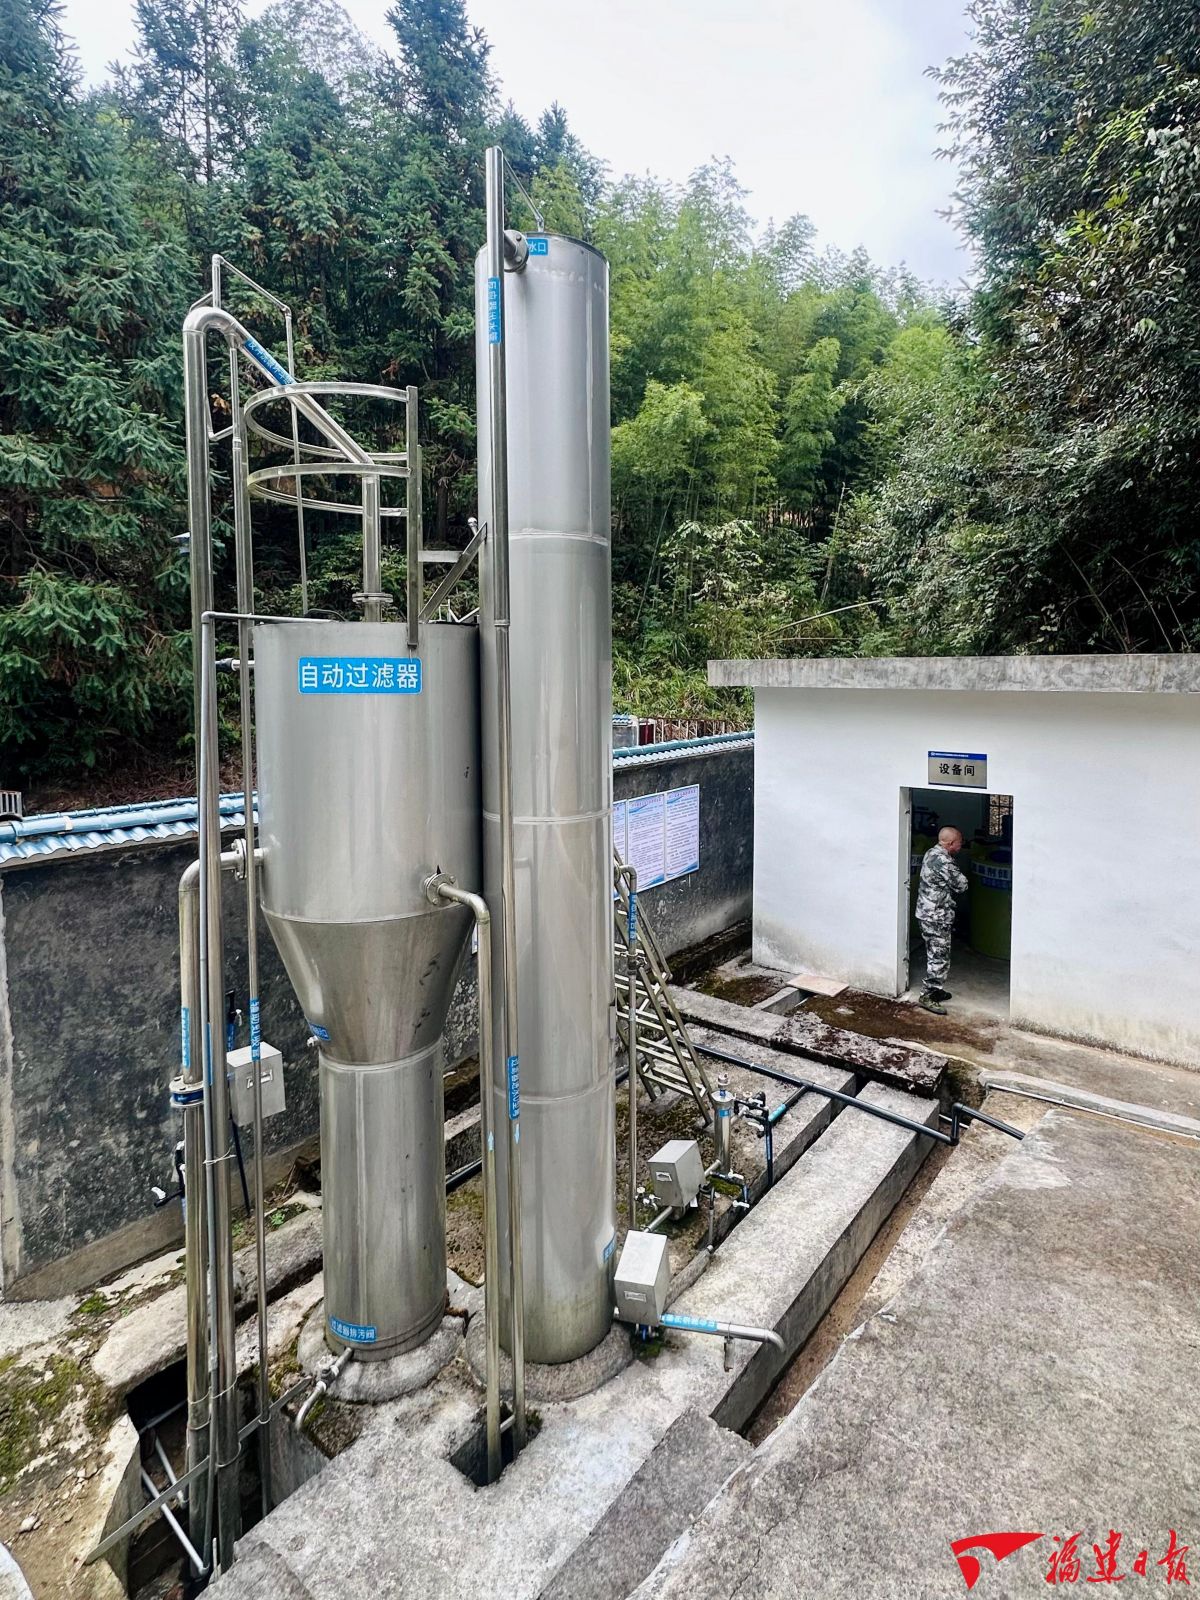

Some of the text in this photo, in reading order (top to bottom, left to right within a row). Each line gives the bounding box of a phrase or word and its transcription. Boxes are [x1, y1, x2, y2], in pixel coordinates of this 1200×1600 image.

[489, 281, 498, 341] 反应器出水管
[301, 662, 418, 688] 自动过滤器
[939, 763, 975, 776] 设备间
[331, 1319, 375, 1340] 过滤器排污阀
